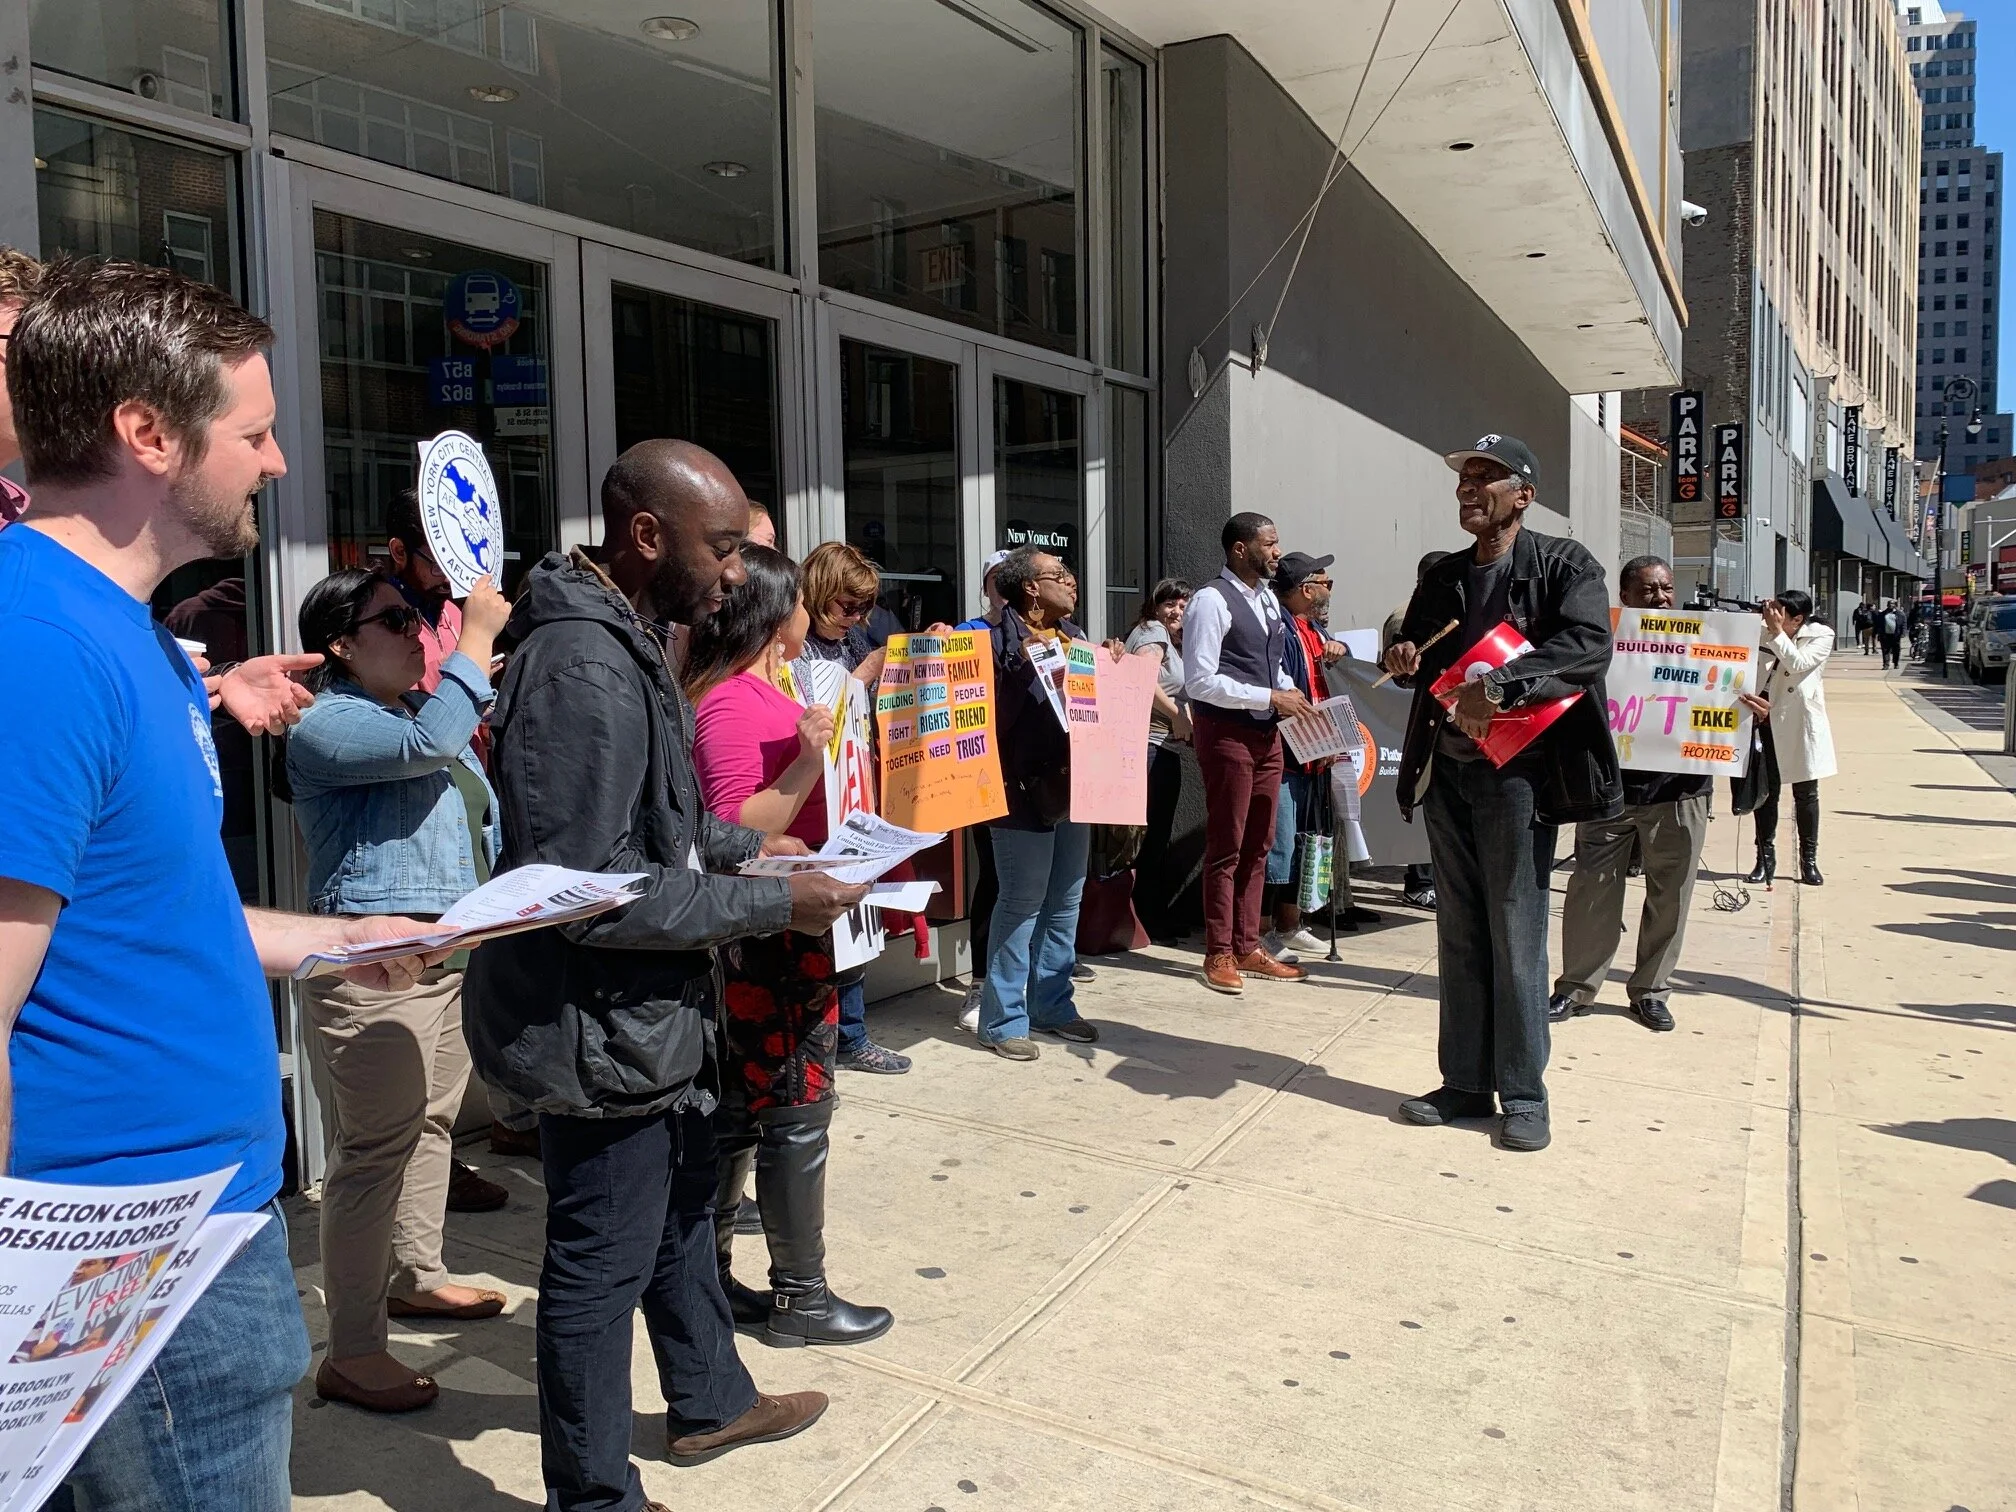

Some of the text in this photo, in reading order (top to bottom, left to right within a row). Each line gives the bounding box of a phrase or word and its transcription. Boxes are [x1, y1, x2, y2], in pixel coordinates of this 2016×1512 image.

[929, 246, 962, 282] EXIT
[1678, 396, 1697, 475] PARK
[1816, 392, 1827, 466] CACIQUE
[1847, 410, 1856, 443] LANE
[438, 441, 456, 460] CITY
[459, 442, 491, 485] CENTRAL
[1721, 429, 1738, 496] PARK
[1888, 450, 1897, 477] LANE
[426, 461, 440, 496] YORK
[441, 490, 458, 511] AFL
[427, 505, 442, 540] NEW
[1640, 618, 1701, 634] NEW YORK
[888, 647, 909, 658] TENANTS
[911, 639, 941, 654] COALITION
[1616, 642, 1747, 660] BUILDING TENANTS
[882, 658, 980, 684] BROOKLYN NEW YORK FAMILY
[1653, 667, 1699, 684] POWER
[878, 694, 914, 711] BUILDING
[954, 686, 985, 700] PEOPLE
[1068, 679, 1095, 693] TENANT
[888, 726, 910, 741] FIGHT
[920, 711, 950, 733] RIGHTS
[955, 706, 986, 729] FRIEND
[1069, 708, 1099, 723] COALITION
[1692, 710, 1733, 728] TAKE
[886, 735, 986, 772] TOGETHER NEED TRUST
[850, 833, 875, 846] Lawsuit
[9, 1200, 115, 1223] ACCION
[113, 1190, 202, 1222] CONTRA
[0, 1216, 187, 1251] DESALOJADORES
[50, 1247, 158, 1321] EVICTION
[87, 1278, 141, 1320] FREE
[7, 1372, 75, 1395] BROOKLYN
[4, 1398, 31, 1413] LOS
[28, 1387, 75, 1409] PEORES
